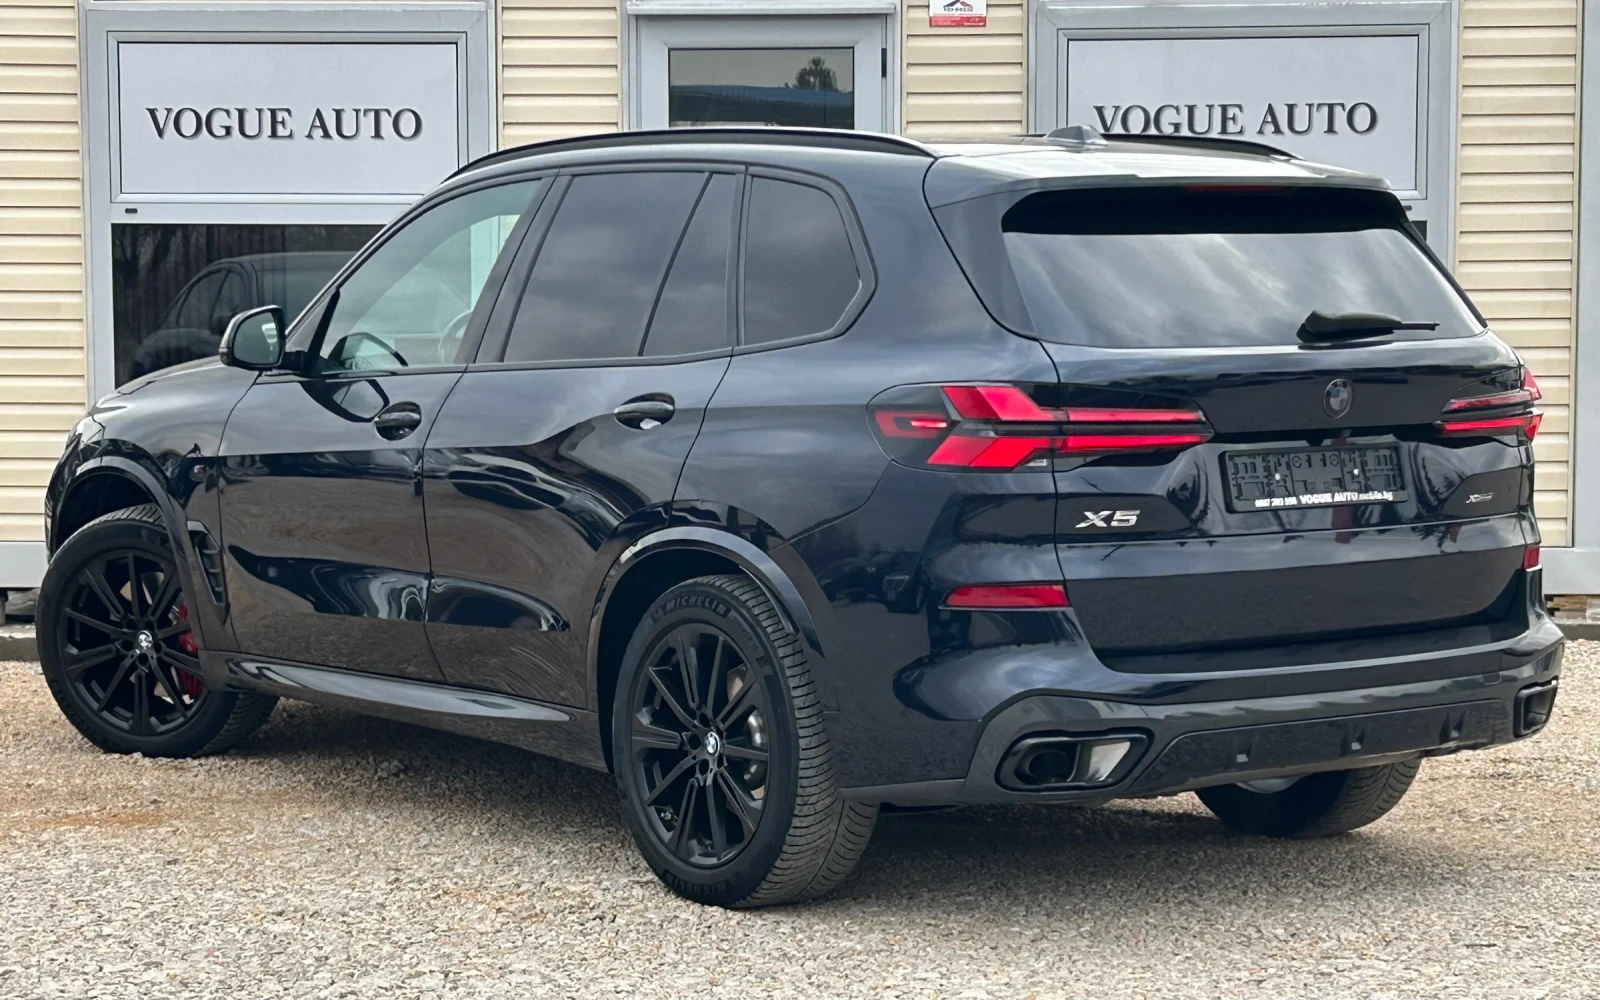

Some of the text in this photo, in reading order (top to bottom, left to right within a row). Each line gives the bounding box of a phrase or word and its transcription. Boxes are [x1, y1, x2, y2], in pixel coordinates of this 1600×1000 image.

[146, 107, 423, 139] VOGUE AUTO
[1093, 102, 1378, 135] VOGUE AUTO
[1299, 492, 1332, 504] VOGUE
[1075, 509, 1140, 528] X5
[664, 595, 728, 615] MICHELIN
